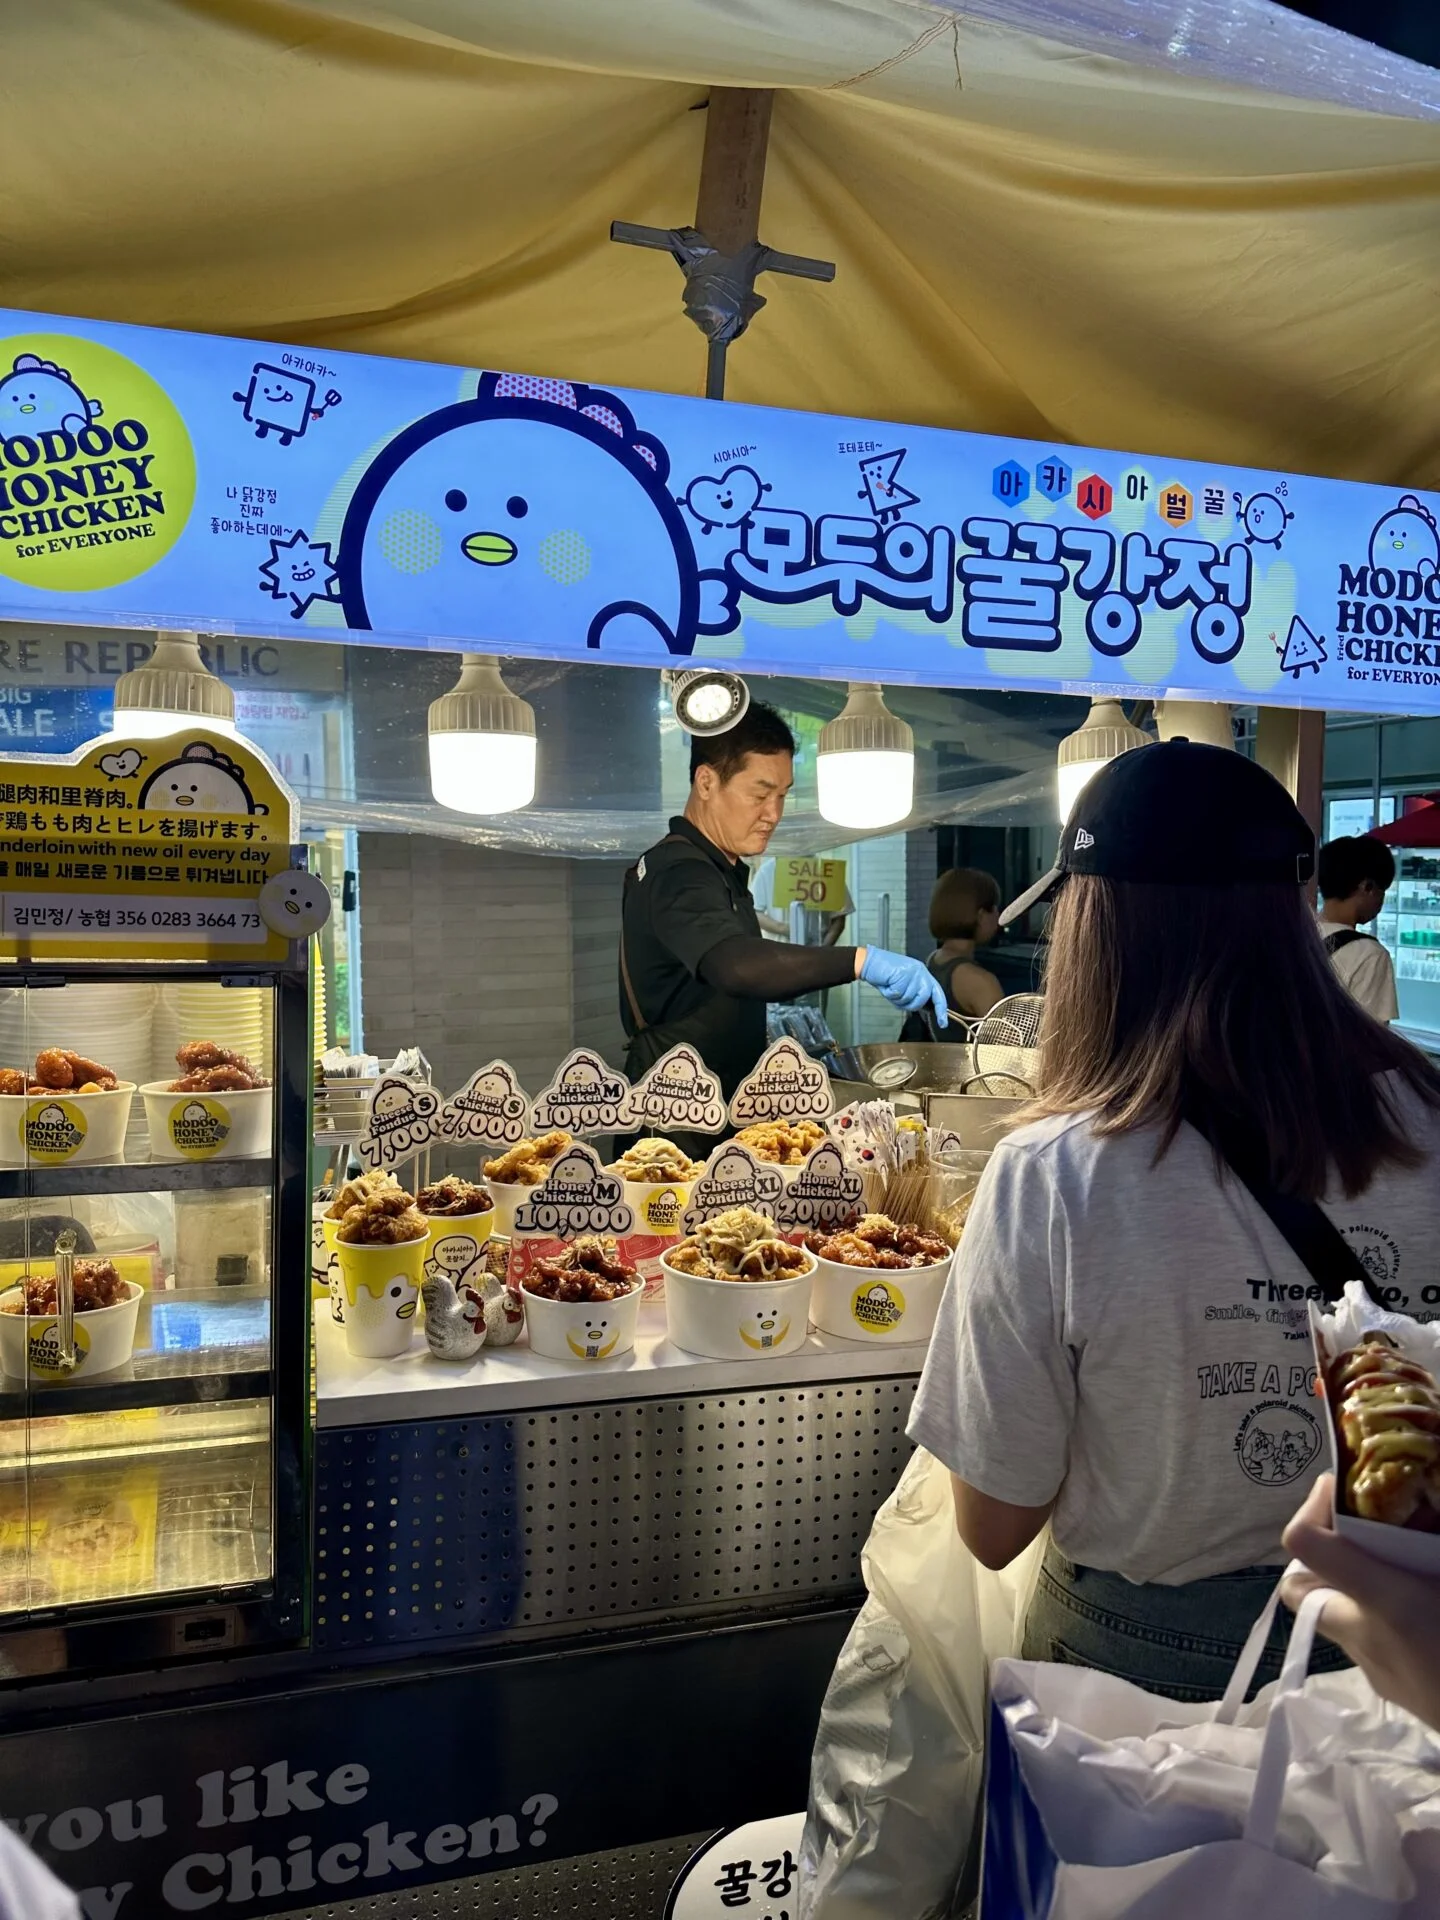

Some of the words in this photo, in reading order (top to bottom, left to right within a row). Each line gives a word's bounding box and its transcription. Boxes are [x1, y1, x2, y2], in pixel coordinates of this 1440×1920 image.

[0, 419, 149, 471] ODOO
[226, 486, 238, 499] 나
[242, 486, 277, 504] 닭강정
[0, 491, 165, 539] CHICKEN
[240, 503, 264, 518] 진짜
[16, 543, 45, 558] for
[46, 523, 156, 553] EVERYONE
[1347, 666, 1369, 680] for
[0, 811, 267, 842] 鶏もも肉とヒレを揚げます。
[78, 841, 116, 857] with
[122, 845, 158, 858] new
[163, 845, 183, 858] oil
[189, 850, 234, 867] every
[240, 848, 270, 866] day
[15, 861, 49, 878] 매일
[56, 863, 107, 880] 새로운
[114, 865, 180, 882] 기름으로
[186, 867, 269, 885] 튀겨냅니다
[788, 860, 834, 878] SALE
[13, 908, 74, 926] 김민정/
[78, 909, 111, 927] 농협
[116, 910, 147, 926] 356
[152, 911, 191, 927] 0283
[196, 912, 236, 928] 3664
[241, 914, 260, 928] 73
[653, 1073, 694, 1089] Cheese
[695, 1083, 712, 1097] M
[745, 1083, 799, 1095] Chicken
[760, 1071, 796, 1083] Fried
[801, 1073, 819, 1087] XL
[547, 1093, 602, 1105] Chicken
[560, 1082, 597, 1094] Fried
[602, 1084, 620, 1098] M
[647, 1081, 693, 1100] Fondue
[371, 1104, 413, 1125] Cheese
[419, 1097, 431, 1111] S
[454, 1097, 502, 1116] Chicken
[468, 1090, 503, 1107] Honey
[508, 1100, 520, 1113] S
[629, 1092, 721, 1126] 10,000
[737, 1092, 829, 1121] 20,000
[173, 1118, 219, 1128] MODOO
[370, 1113, 416, 1138] Fondue
[443, 1105, 523, 1142] 7,000
[534, 1103, 635, 1132] 10,000
[546, 1179, 594, 1194] Honey
[596, 1183, 616, 1200] M
[699, 1178, 754, 1195] Cheese
[757, 1177, 779, 1194] XL
[787, 1183, 841, 1200] Chicken
[800, 1171, 841, 1188] Honey
[842, 1178, 860, 1194] XL
[531, 1190, 594, 1206] Chicken
[696, 1190, 756, 1208] Fondue
[515, 1204, 632, 1237] 10,000
[1205, 1304, 1261, 1322] Smile,
[29, 1346, 60, 1358] HON
[30, 1338, 78, 1349] MOD
[1198, 1361, 1257, 1398] TAKE
[1261, 1365, 1280, 1393] A
[196, 1760, 370, 1828] like
[162, 1792, 559, 1911] Chicken?
